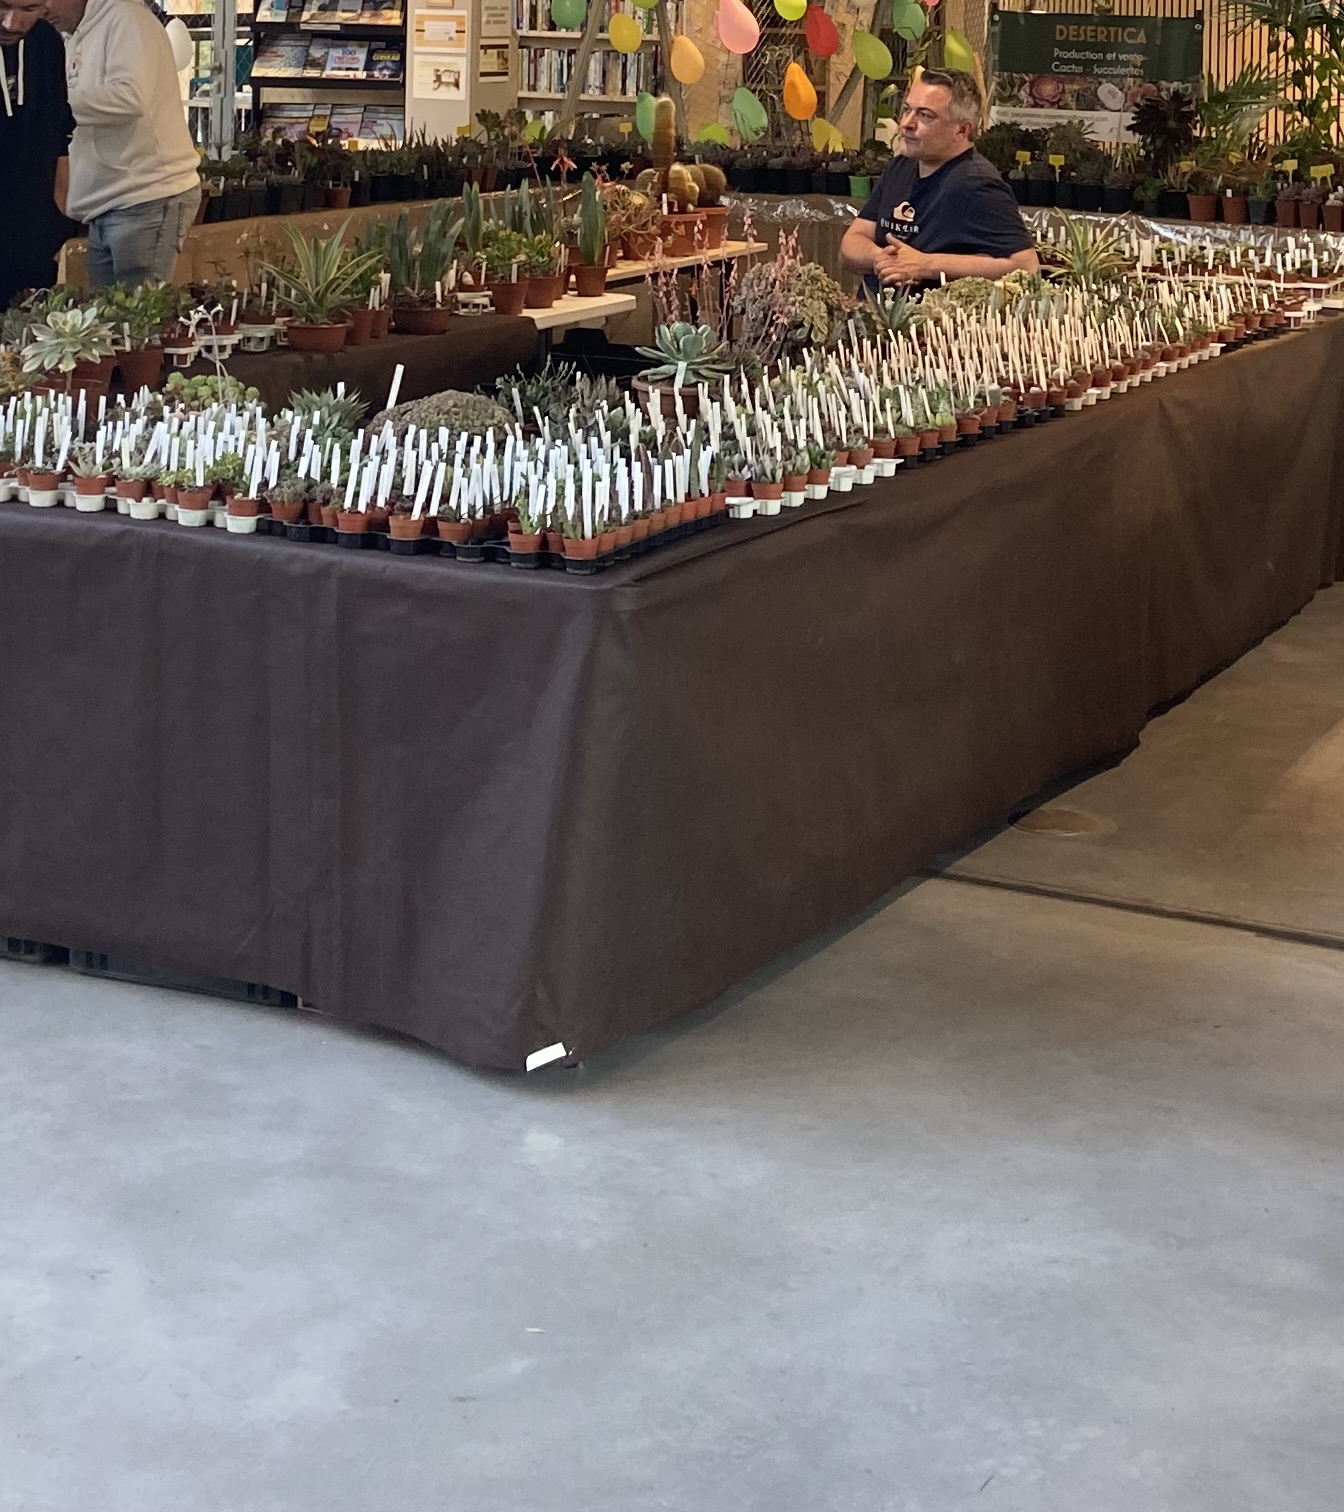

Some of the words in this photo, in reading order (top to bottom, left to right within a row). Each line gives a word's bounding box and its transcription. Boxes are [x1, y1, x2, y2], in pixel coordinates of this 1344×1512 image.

[1056, 25, 1147, 44] DESERTICA
[1053, 47, 1104, 60] Production
[1106, 51, 1117, 61] et
[1051, 61, 1084, 73] Cactus
